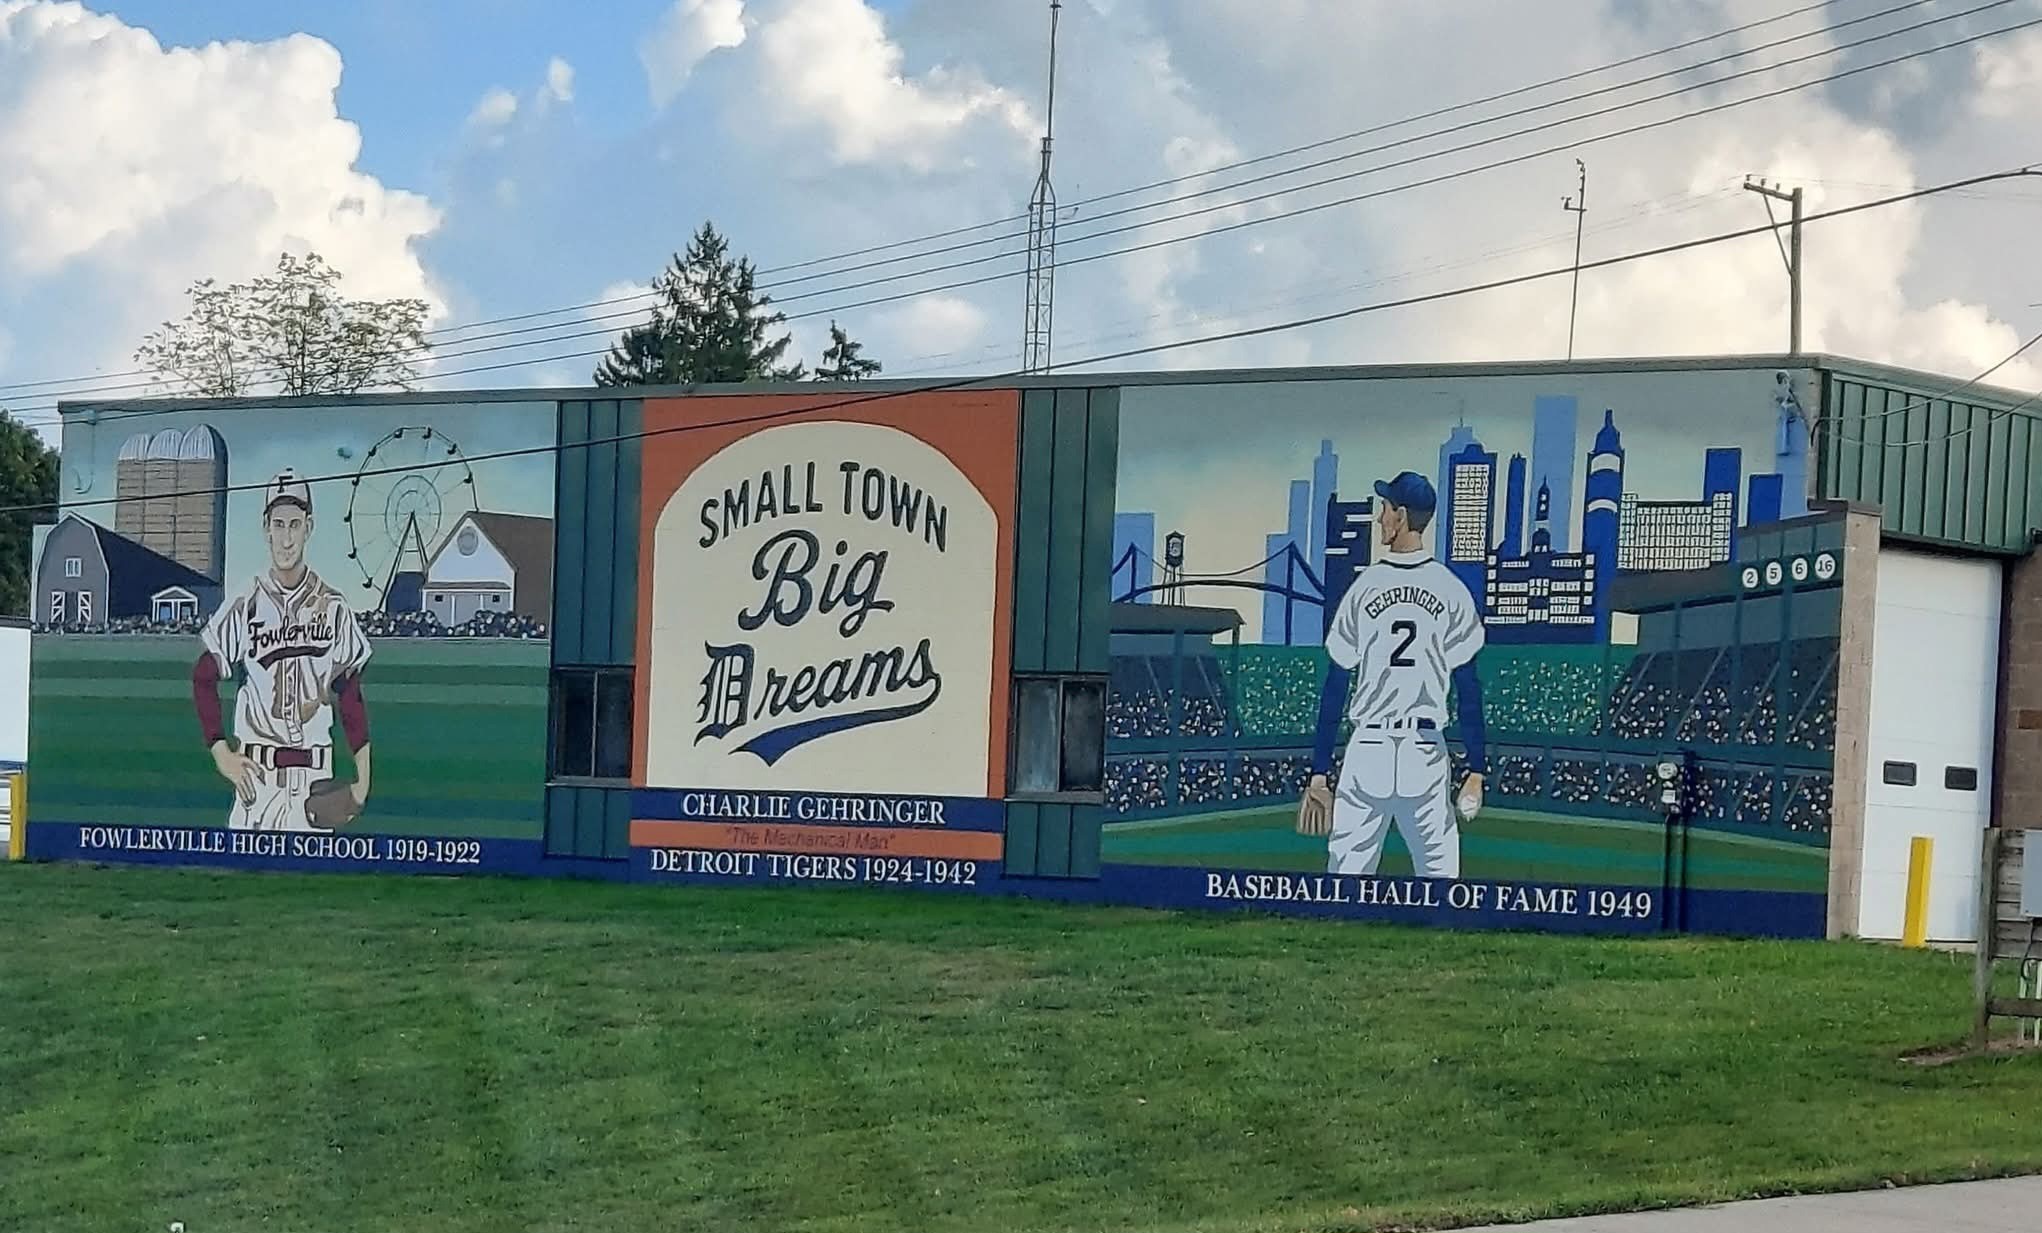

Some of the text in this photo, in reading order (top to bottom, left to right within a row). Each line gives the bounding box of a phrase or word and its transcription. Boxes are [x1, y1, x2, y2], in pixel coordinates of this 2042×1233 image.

[277, 475, 293, 494] F
[699, 461, 948, 553] SMALL TOWN
[738, 529, 895, 638] Big
[1746, 571, 1754, 584] 2
[1770, 568, 1778, 579] 5
[1795, 563, 1803, 575] 6
[1818, 560, 1833, 573] 16
[1365, 586, 1445, 621] GEHRINGER
[248, 614, 334, 658] Fowlerville
[1390, 620, 1417, 667] 2
[694, 638, 941, 747] Dreams
[683, 793, 946, 824] CHARLIE GEHRINGER
[80, 827, 481, 864] FOWLERVILLE HIGH SCHOOL 1919-1922
[651, 849, 976, 885] DETROIT TIGERS 1924-1942
[1205, 873, 1651, 918] BASEBALL HALL OF FAME 1949
